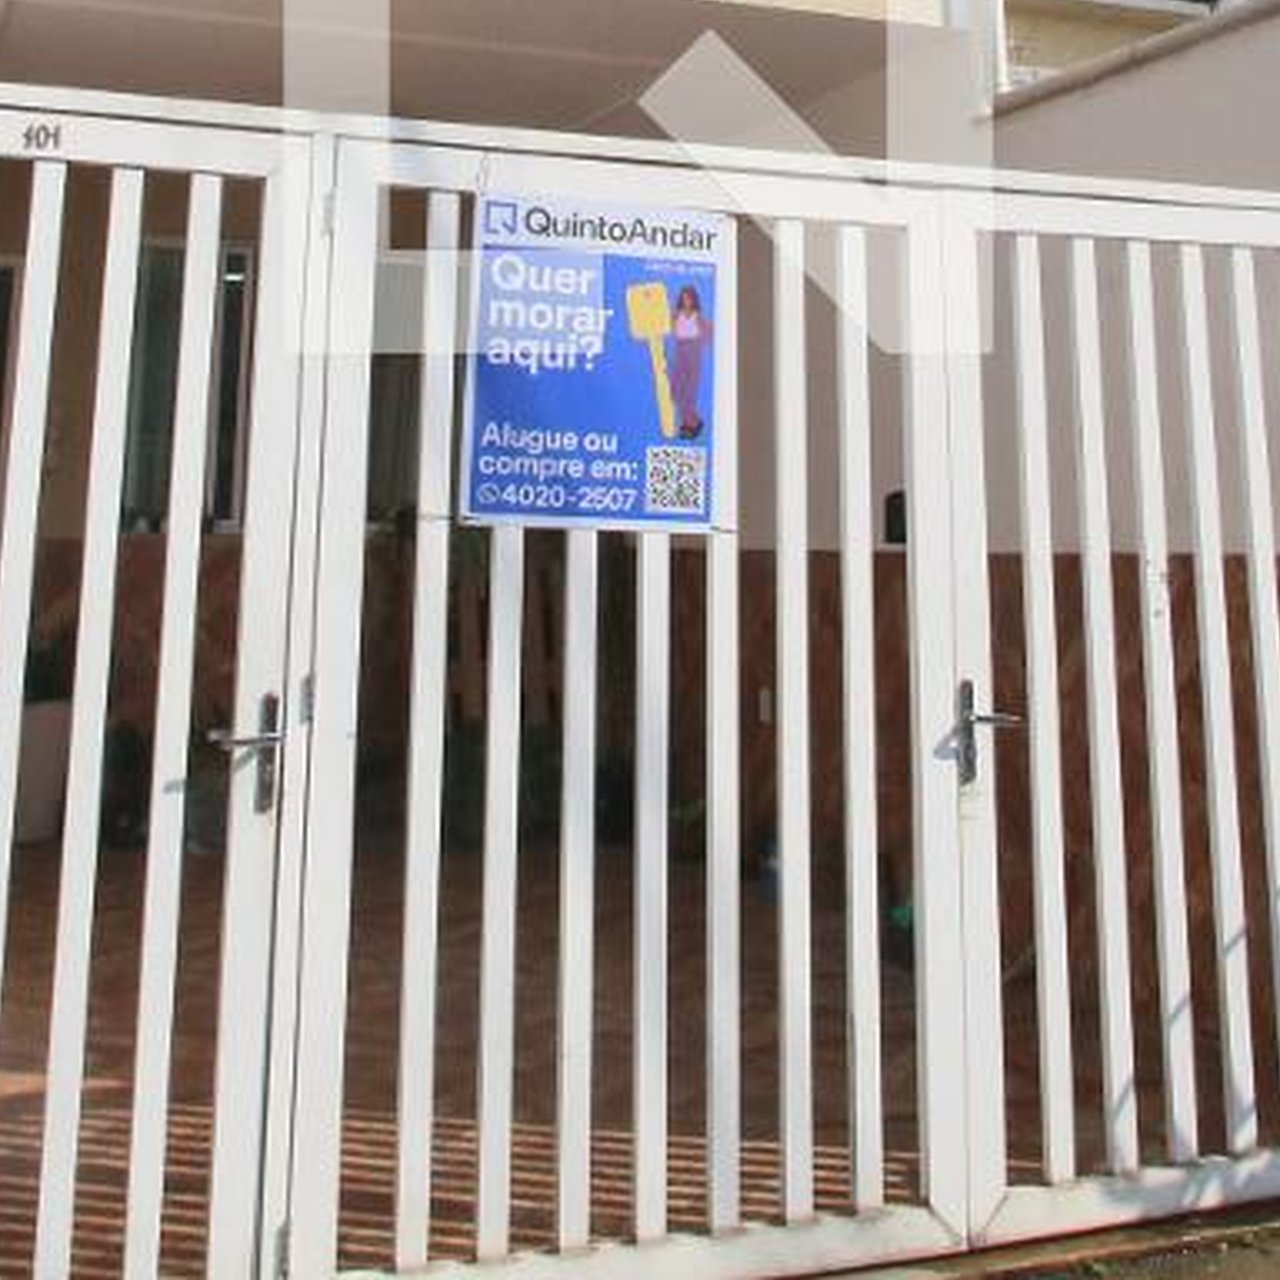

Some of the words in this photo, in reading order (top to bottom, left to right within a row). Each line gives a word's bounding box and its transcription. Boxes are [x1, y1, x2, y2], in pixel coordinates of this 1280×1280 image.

[524, 207, 717, 251] QuintoAndar
[491, 254, 597, 294] Quer
[488, 298, 614, 333] morar
[486, 333, 602, 374] aqui?
[481, 422, 578, 453] Alugue
[584, 430, 618, 453] ou
[478, 456, 585, 484] compre
[590, 460, 638, 482] em:
[501, 483, 637, 510] 4020-2507
